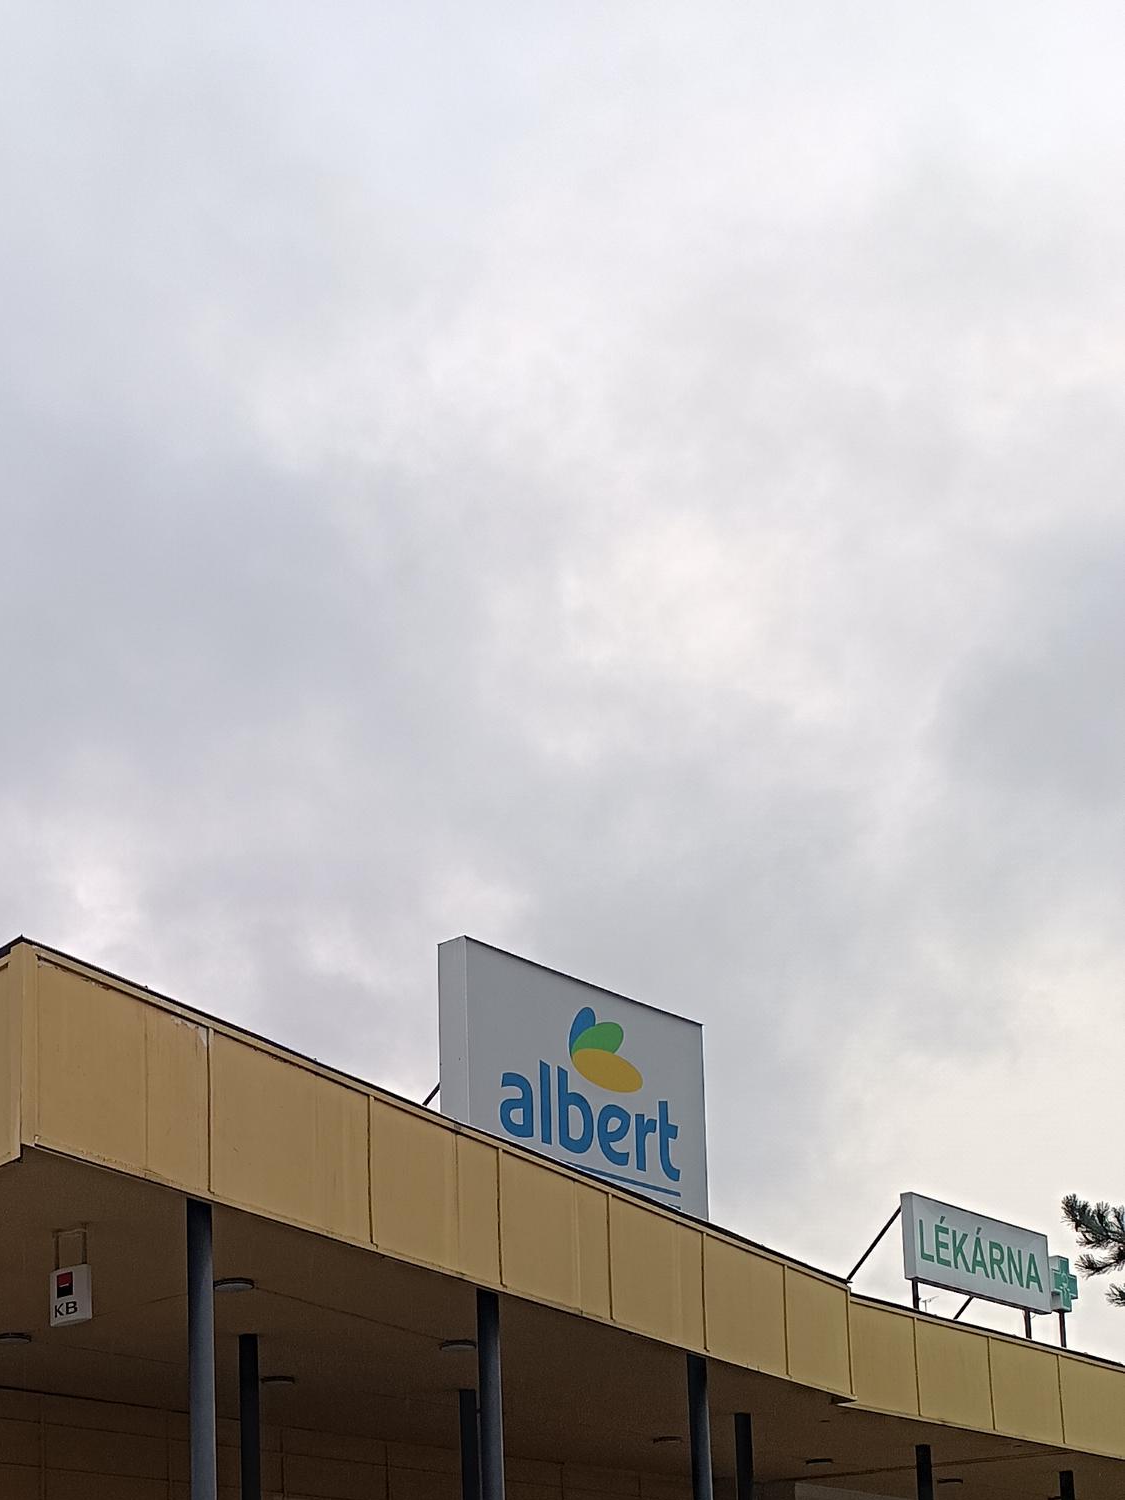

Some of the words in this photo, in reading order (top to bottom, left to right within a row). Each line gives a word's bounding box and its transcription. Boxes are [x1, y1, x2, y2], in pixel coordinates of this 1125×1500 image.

[499, 1060, 681, 1182] albert
[918, 1215, 1043, 1293] LÉKÁRNA
[55, 1301, 77, 1318] KB
